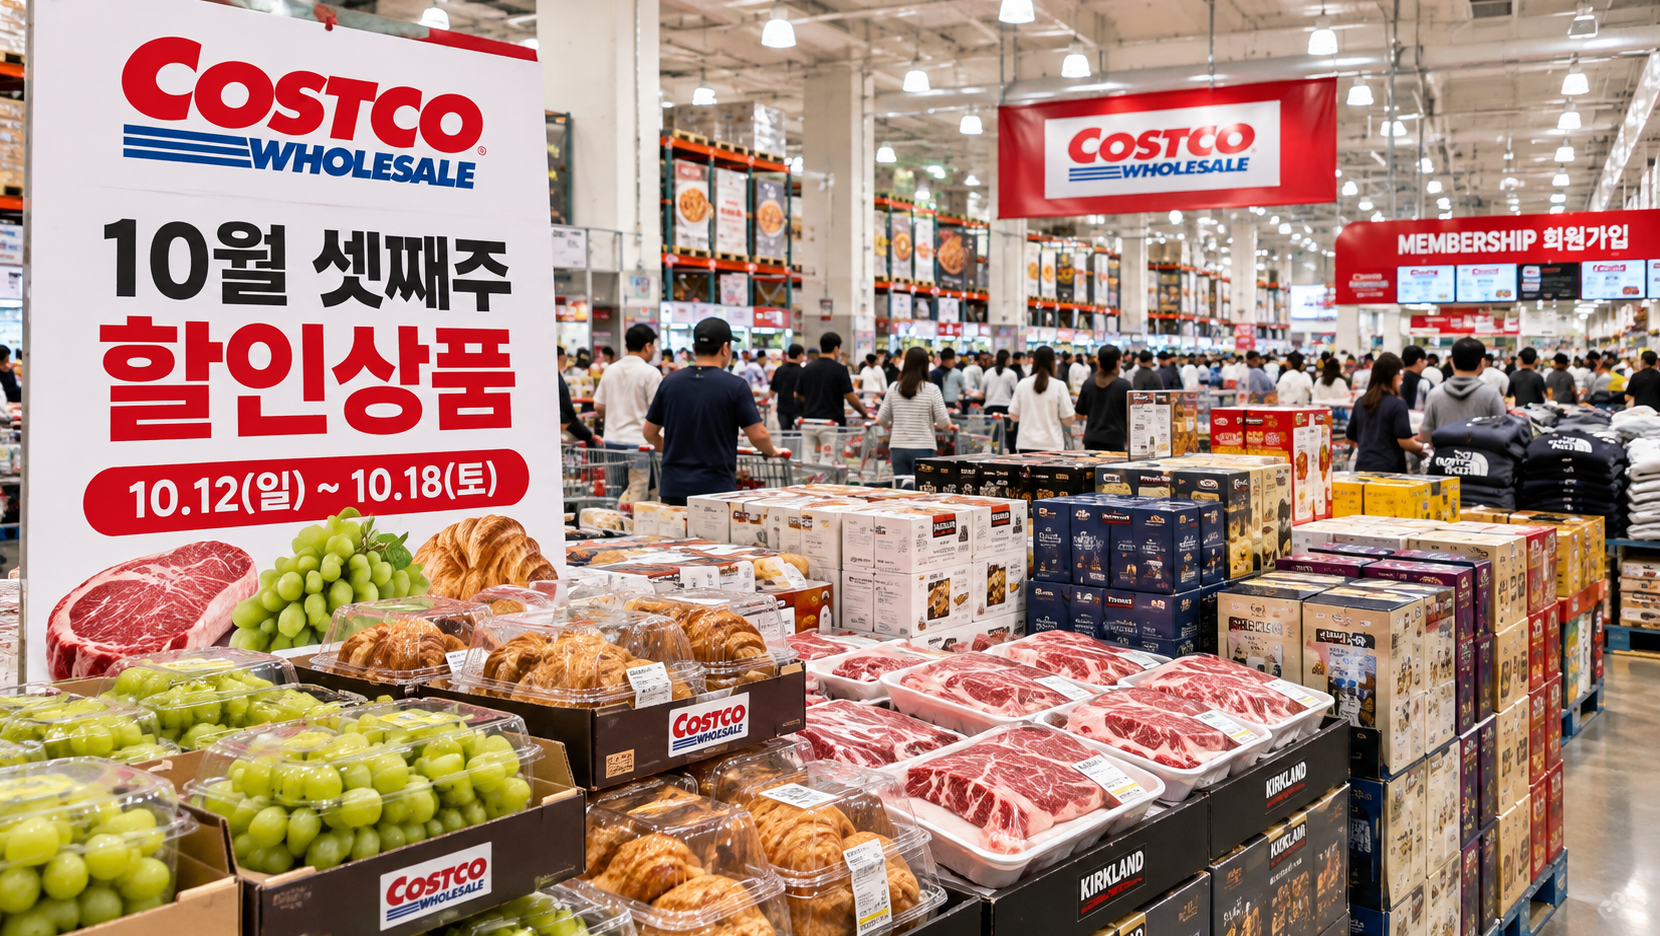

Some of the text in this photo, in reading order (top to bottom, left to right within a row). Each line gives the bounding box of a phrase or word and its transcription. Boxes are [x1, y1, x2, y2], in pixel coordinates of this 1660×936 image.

[121, 36, 483, 153] COSTCO
[248, 137, 476, 189] WHOLESALE
[1068, 123, 1255, 164] COSTCO
[1121, 157, 1250, 179] WHOLESALE
[1397, 224, 1629, 255] MEMBERSHIP 회원가입
[104, 218, 512, 312] 10월 셋째주
[100, 316, 516, 442] 할인상품
[129, 469, 306, 518] 10.12(일)
[351, 459, 498, 503] 10.18(토)
[672, 704, 746, 739] COSTCO
[1265, 761, 1307, 799] KIRKLAND
[386, 857, 487, 906] COSTCO
[418, 879, 484, 910] WHOLESALE
[1080, 850, 1144, 901] KIRKLAND
